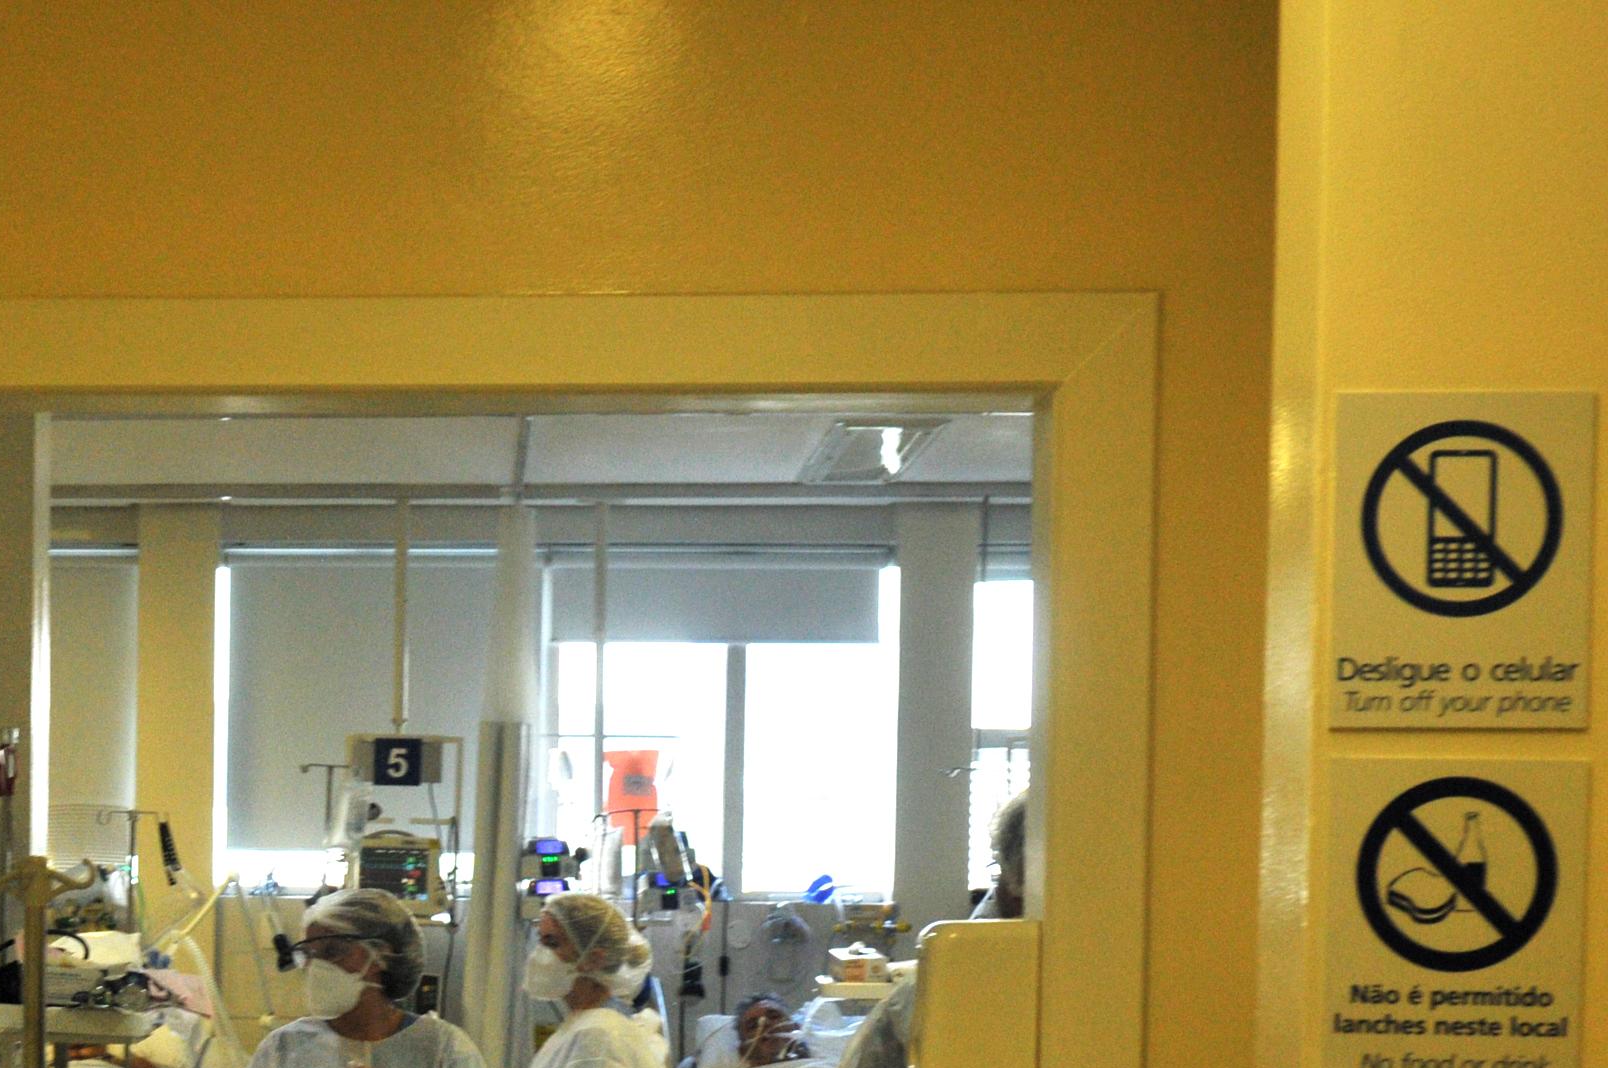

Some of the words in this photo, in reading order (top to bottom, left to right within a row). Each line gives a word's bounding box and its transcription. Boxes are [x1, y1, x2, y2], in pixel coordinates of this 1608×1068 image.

[1337, 656, 1450, 688] Desligue
[1461, 663, 1481, 682] o
[1490, 656, 1580, 682] celular
[1344, 690, 1391, 713] Turn
[1400, 690, 1435, 713] off
[1437, 695, 1492, 718] your
[1497, 691, 1573, 717] phone
[387, 747, 409, 778] 5
[1349, 984, 1401, 1005] Não
[1407, 985, 1424, 1005] é
[1430, 986, 1554, 1010] permitido
[1333, 1013, 1427, 1036] lanches
[1434, 1017, 1503, 1037] neste
[1511, 1016, 1569, 1038] local
